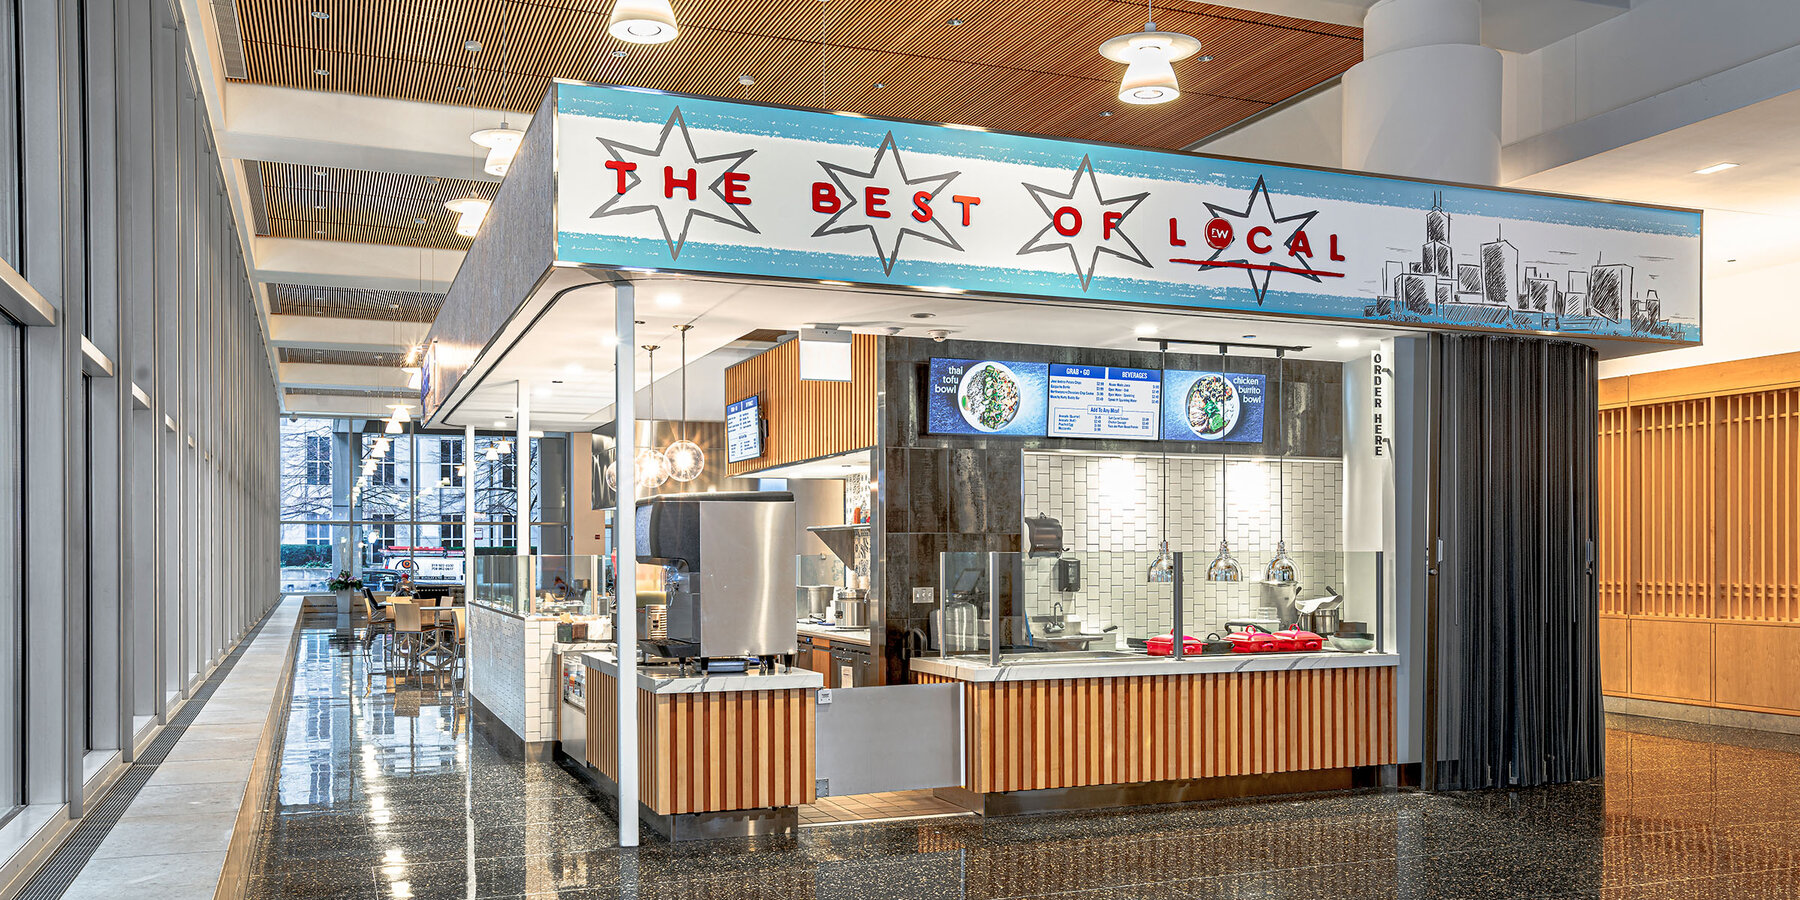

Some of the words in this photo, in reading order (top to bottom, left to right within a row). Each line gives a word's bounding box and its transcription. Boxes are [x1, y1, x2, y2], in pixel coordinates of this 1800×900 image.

[604, 160, 752, 206] THE
[811, 182, 981, 226] BEST
[1053, 206, 1122, 240] OF
[948, 366, 963, 375] thai
[942, 375, 959, 384] tofu
[1233, 376, 1259, 385] chicken
[1374, 354, 1382, 408] ORDER
[934, 384, 957, 394] bowl
[1238, 385, 1261, 394] burrito
[1243, 394, 1261, 404] bowl
[1374, 413, 1382, 456] HERE
